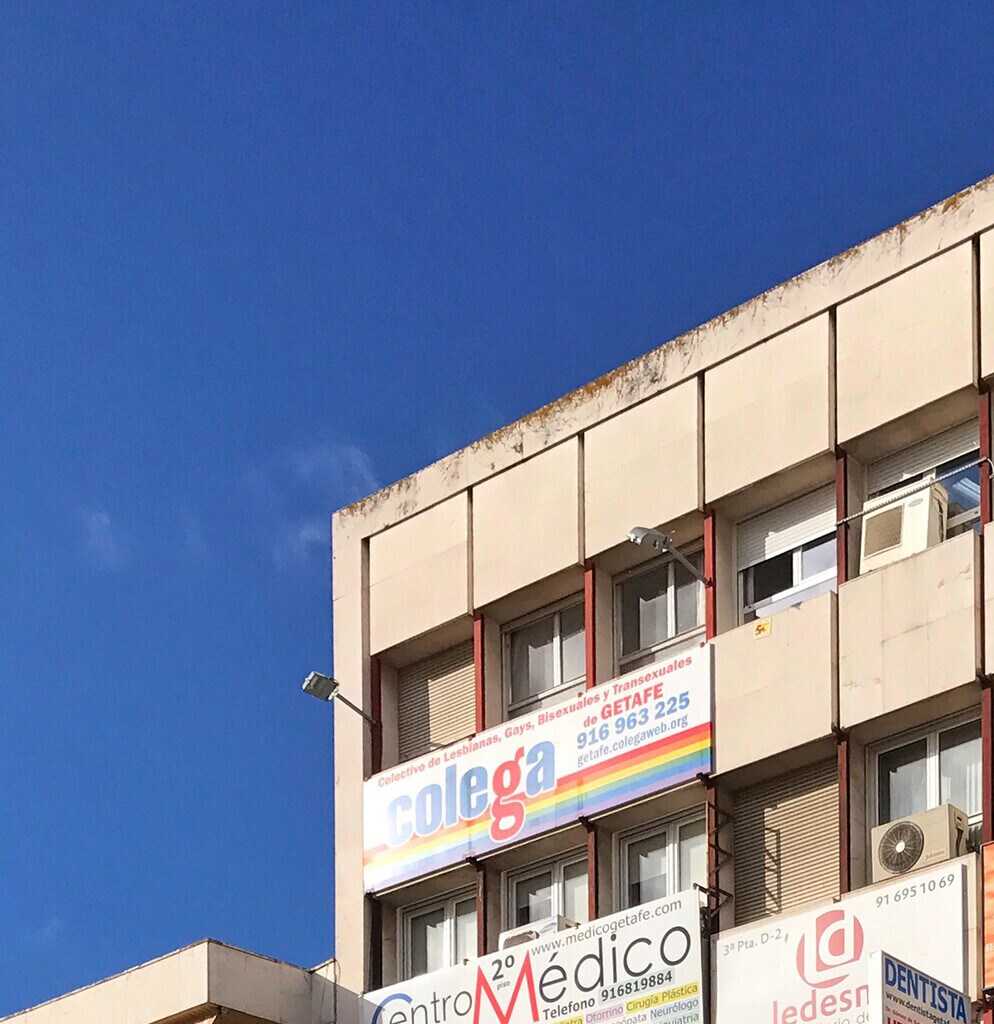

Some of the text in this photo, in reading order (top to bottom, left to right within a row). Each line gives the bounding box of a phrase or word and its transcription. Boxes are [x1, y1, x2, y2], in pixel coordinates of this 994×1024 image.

[378, 763, 426, 788] Colectivo
[428, 755, 441, 769] de
[444, 734, 502, 763] Lesbianas,
[505, 721, 535, 739] Gays,
[538, 694, 600, 723] Bisexuales
[612, 655, 692, 694] Transexuales
[577, 691, 690, 750] 916 963 225
[583, 682, 664, 728] de GETAFE
[577, 714, 689, 767] getafe.colegaweb.org
[388, 740, 556, 842] colega
[875, 873, 955, 908] 91 695 10 69
[531, 898, 682, 956] www.medicogetafe.com
[738, 938, 758, 952] Pta.
[543, 970, 673, 1021] Telefono 916819884
[586, 1006, 624, 1023] Otorrino
[626, 995, 660, 1014] Cirugía
[662, 983, 698, 1002] Plástica
[884, 957, 967, 1024] DENTISTA
